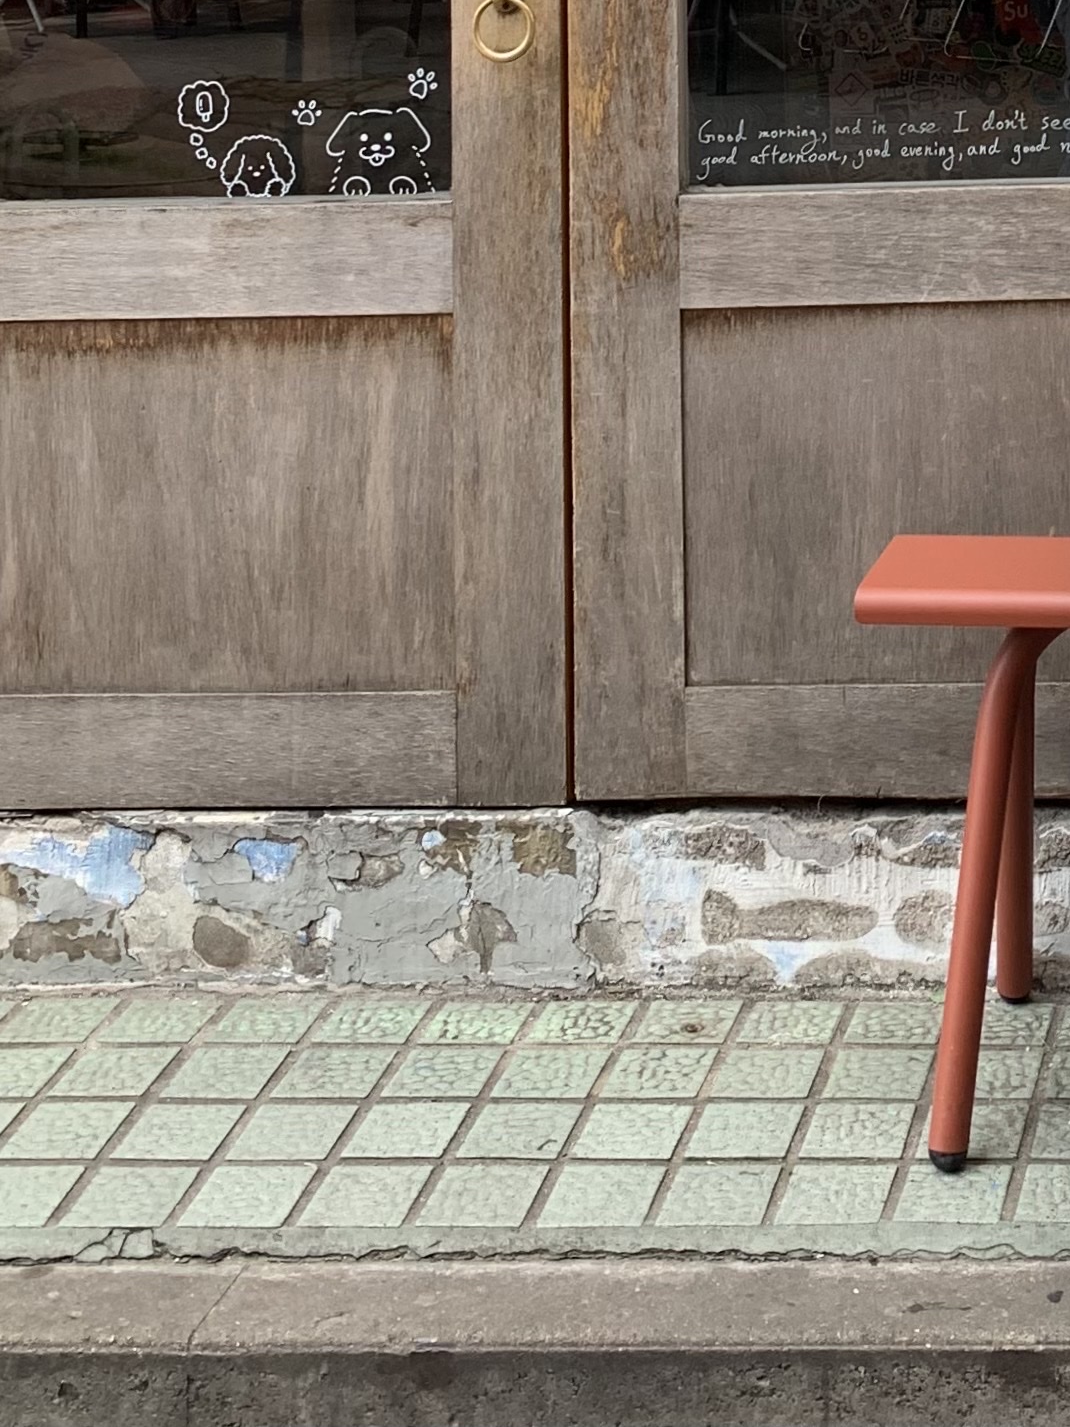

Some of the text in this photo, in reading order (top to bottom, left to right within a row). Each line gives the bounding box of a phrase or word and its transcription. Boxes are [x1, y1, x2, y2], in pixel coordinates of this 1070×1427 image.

[698, 118, 747, 144] Good
[758, 125, 827, 155] morning,
[835, 118, 861, 134] and
[872, 119, 887, 134] in
[898, 122, 941, 136] case
[953, 110, 969, 133] I
[982, 109, 1028, 132] don't
[696, 146, 737, 180] good
[750, 144, 848, 166] afternoon,
[852, 138, 891, 169] good
[900, 141, 963, 171] evening,
[966, 136, 1001, 156] and
[1011, 132, 1050, 165] good
